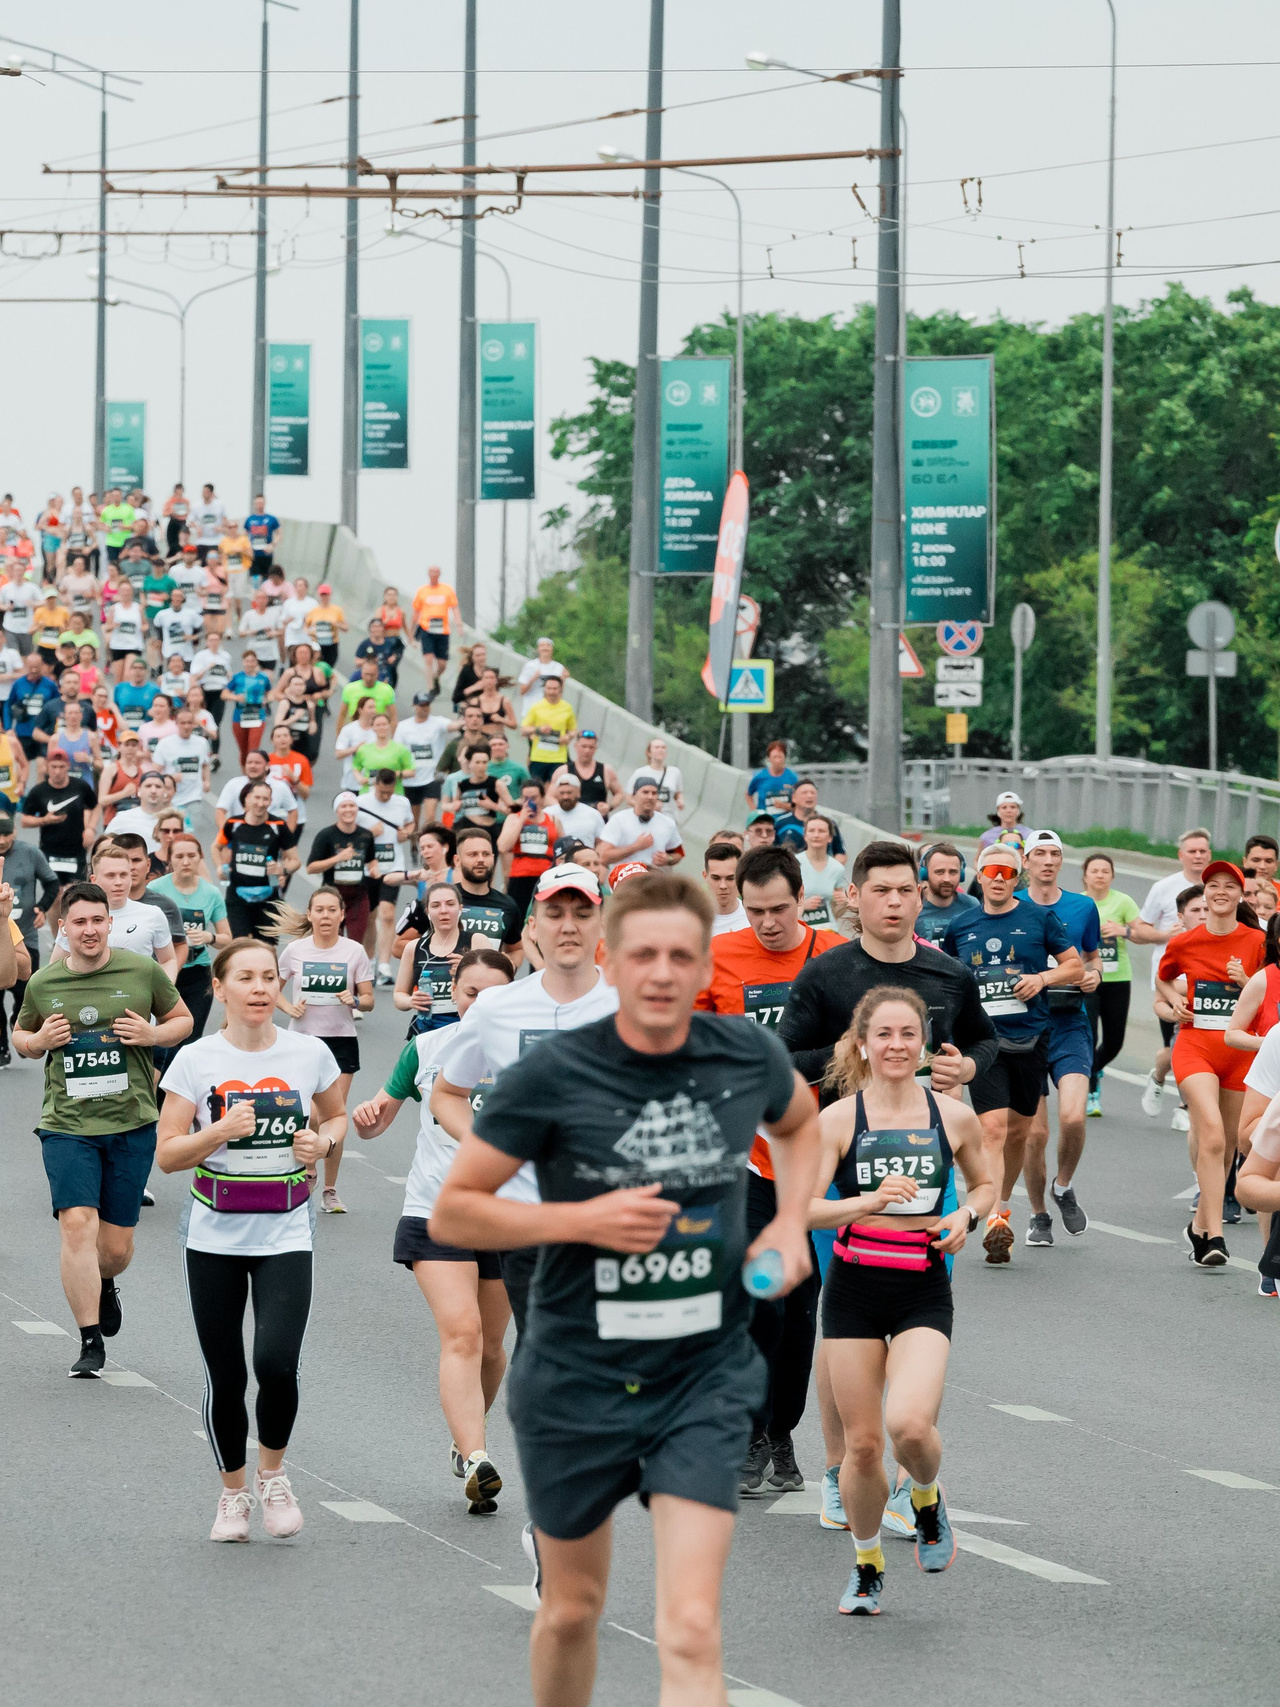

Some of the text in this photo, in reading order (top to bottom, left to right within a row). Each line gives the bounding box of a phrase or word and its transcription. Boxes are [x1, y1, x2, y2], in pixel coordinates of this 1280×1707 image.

[911, 506, 987, 518] ХИМИКЛАР
[911, 543, 921, 553] 2
[912, 555, 947, 567] 18:00
[468, 919, 499, 931] 7173
[310, 974, 343, 986] 7197
[1203, 997, 1238, 1010] 8672
[75, 1051, 121, 1068] 7548
[249, 1116, 297, 1136] 766
[861, 1156, 935, 1179] E 5375
[621, 1247, 713, 1285] 6968
